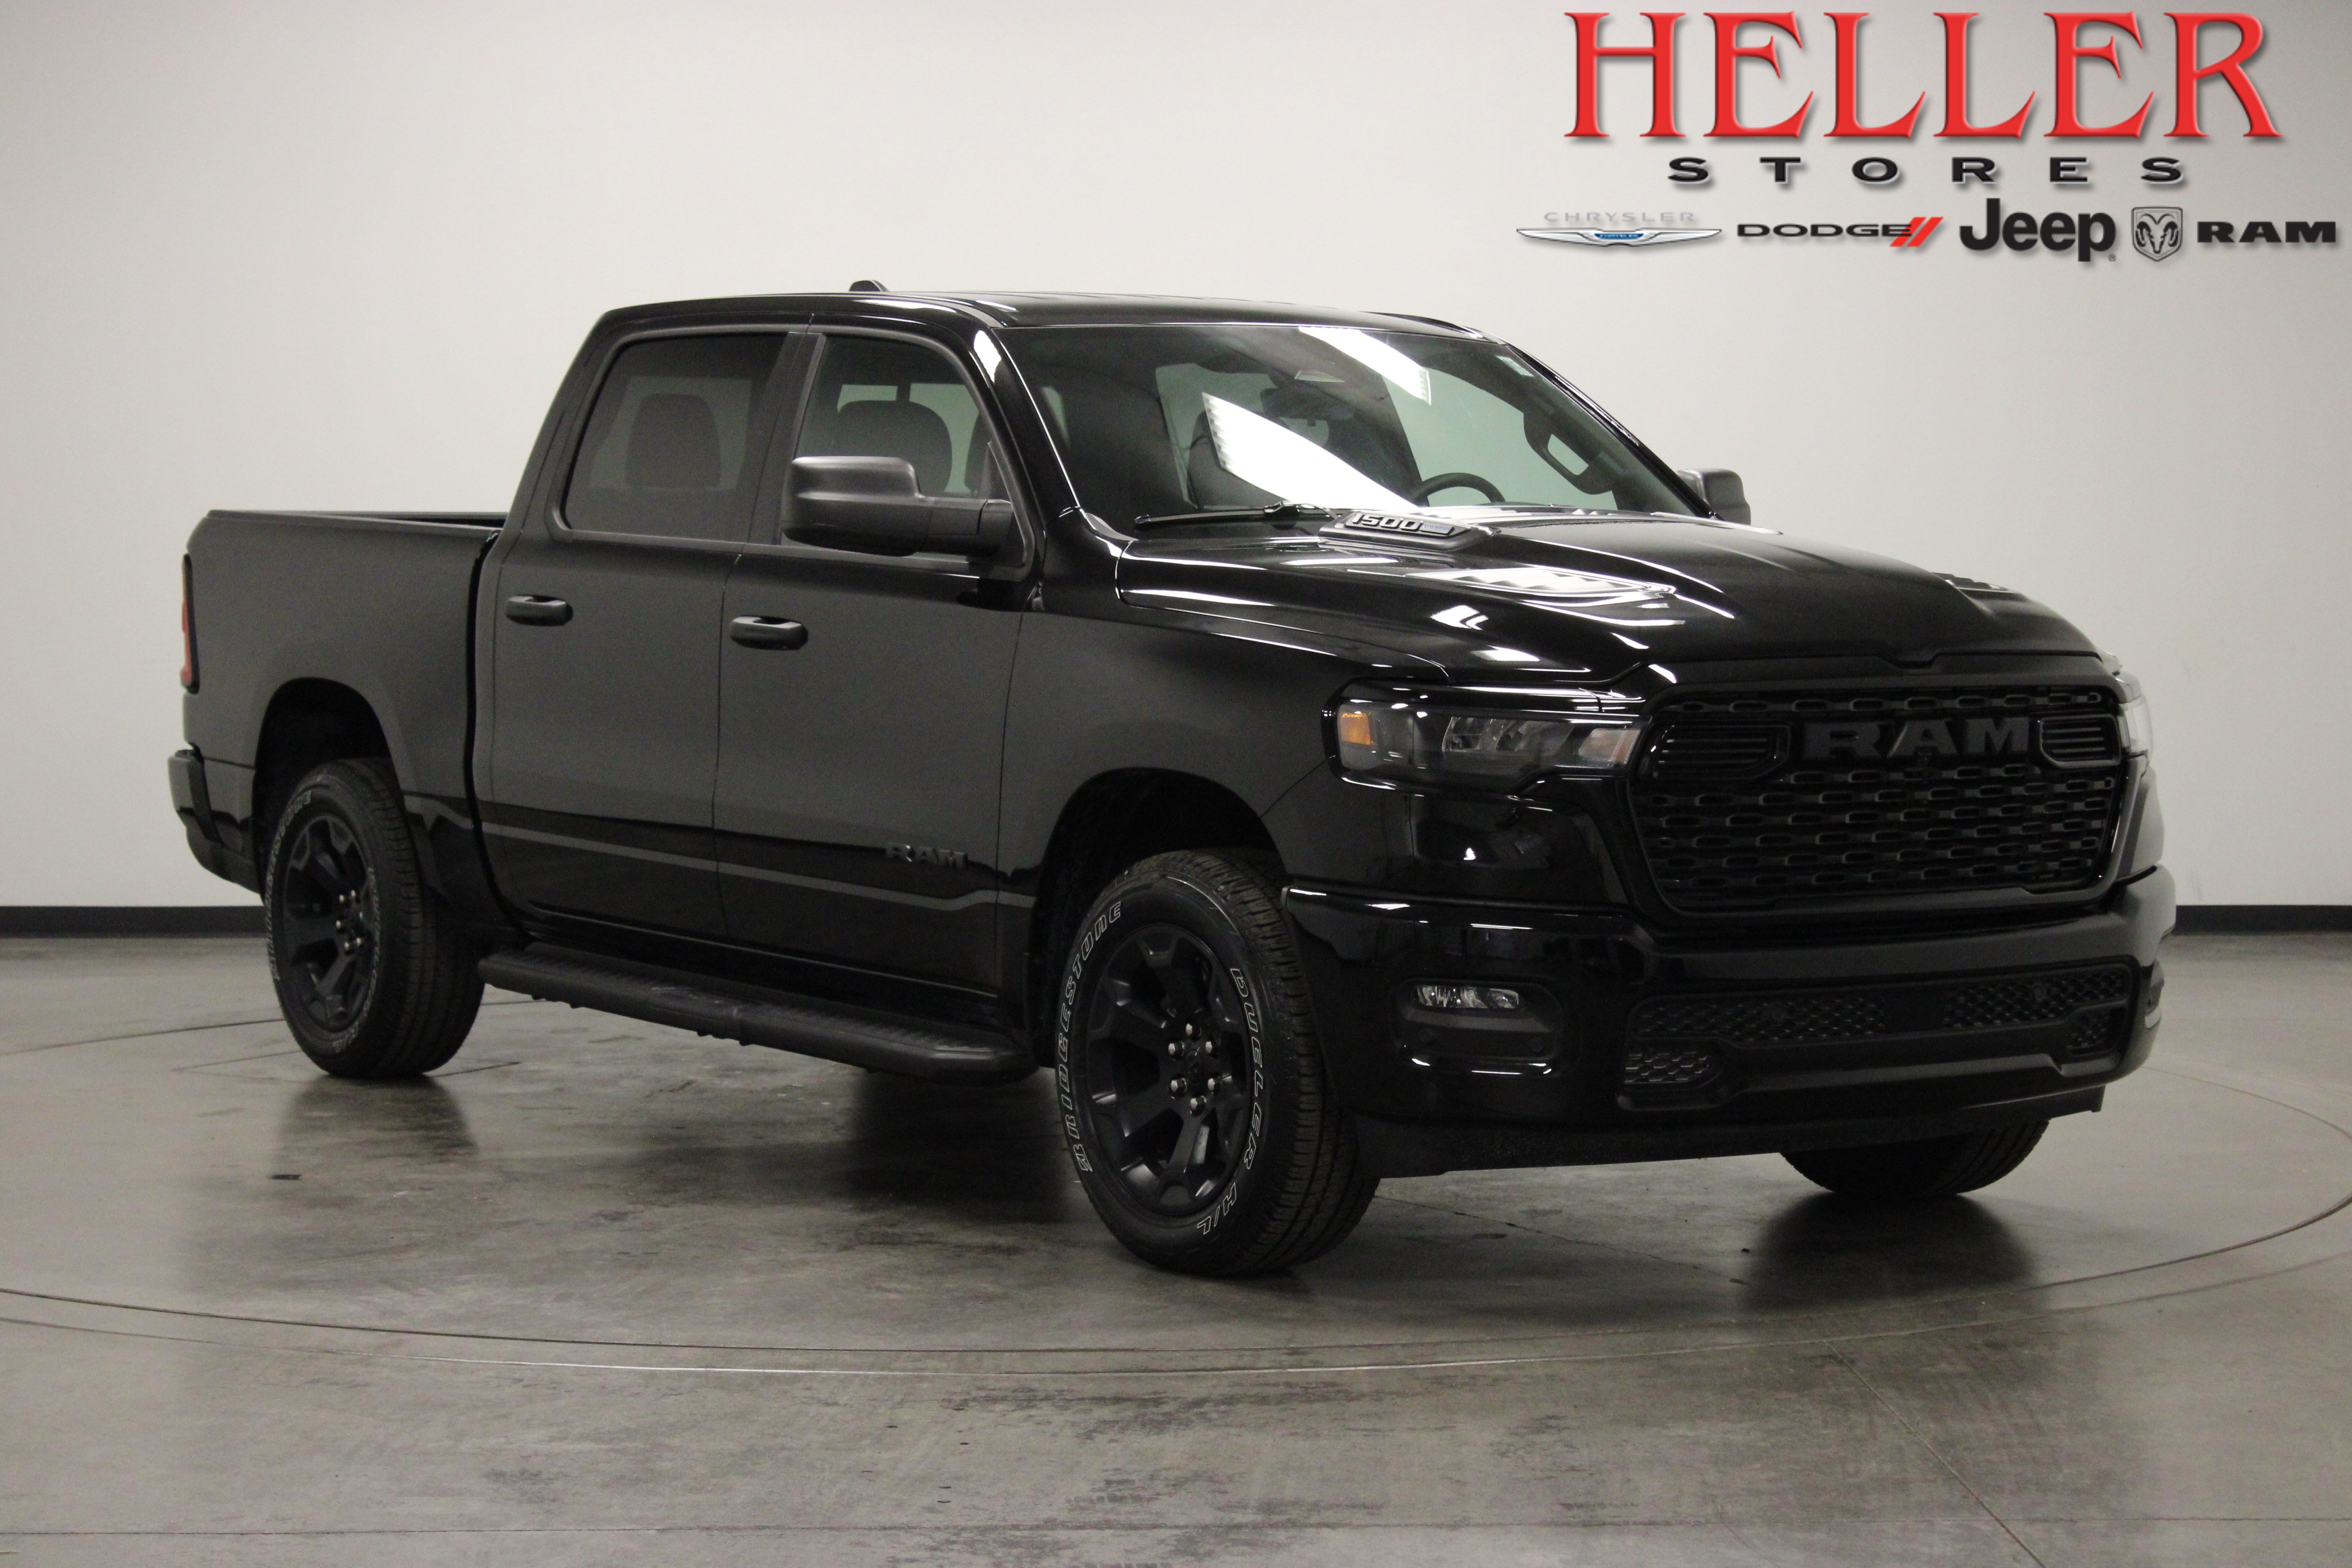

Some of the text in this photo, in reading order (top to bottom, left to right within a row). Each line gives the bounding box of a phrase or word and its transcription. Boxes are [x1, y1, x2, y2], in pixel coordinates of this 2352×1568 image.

[1352, 513, 1423, 531] 1500
[1802, 717, 2030, 758] RAM
[885, 842, 968, 869] RAM
[1058, 901, 1121, 1173] BRIDGESTONE
[1230, 968, 1263, 1170] DUELER
